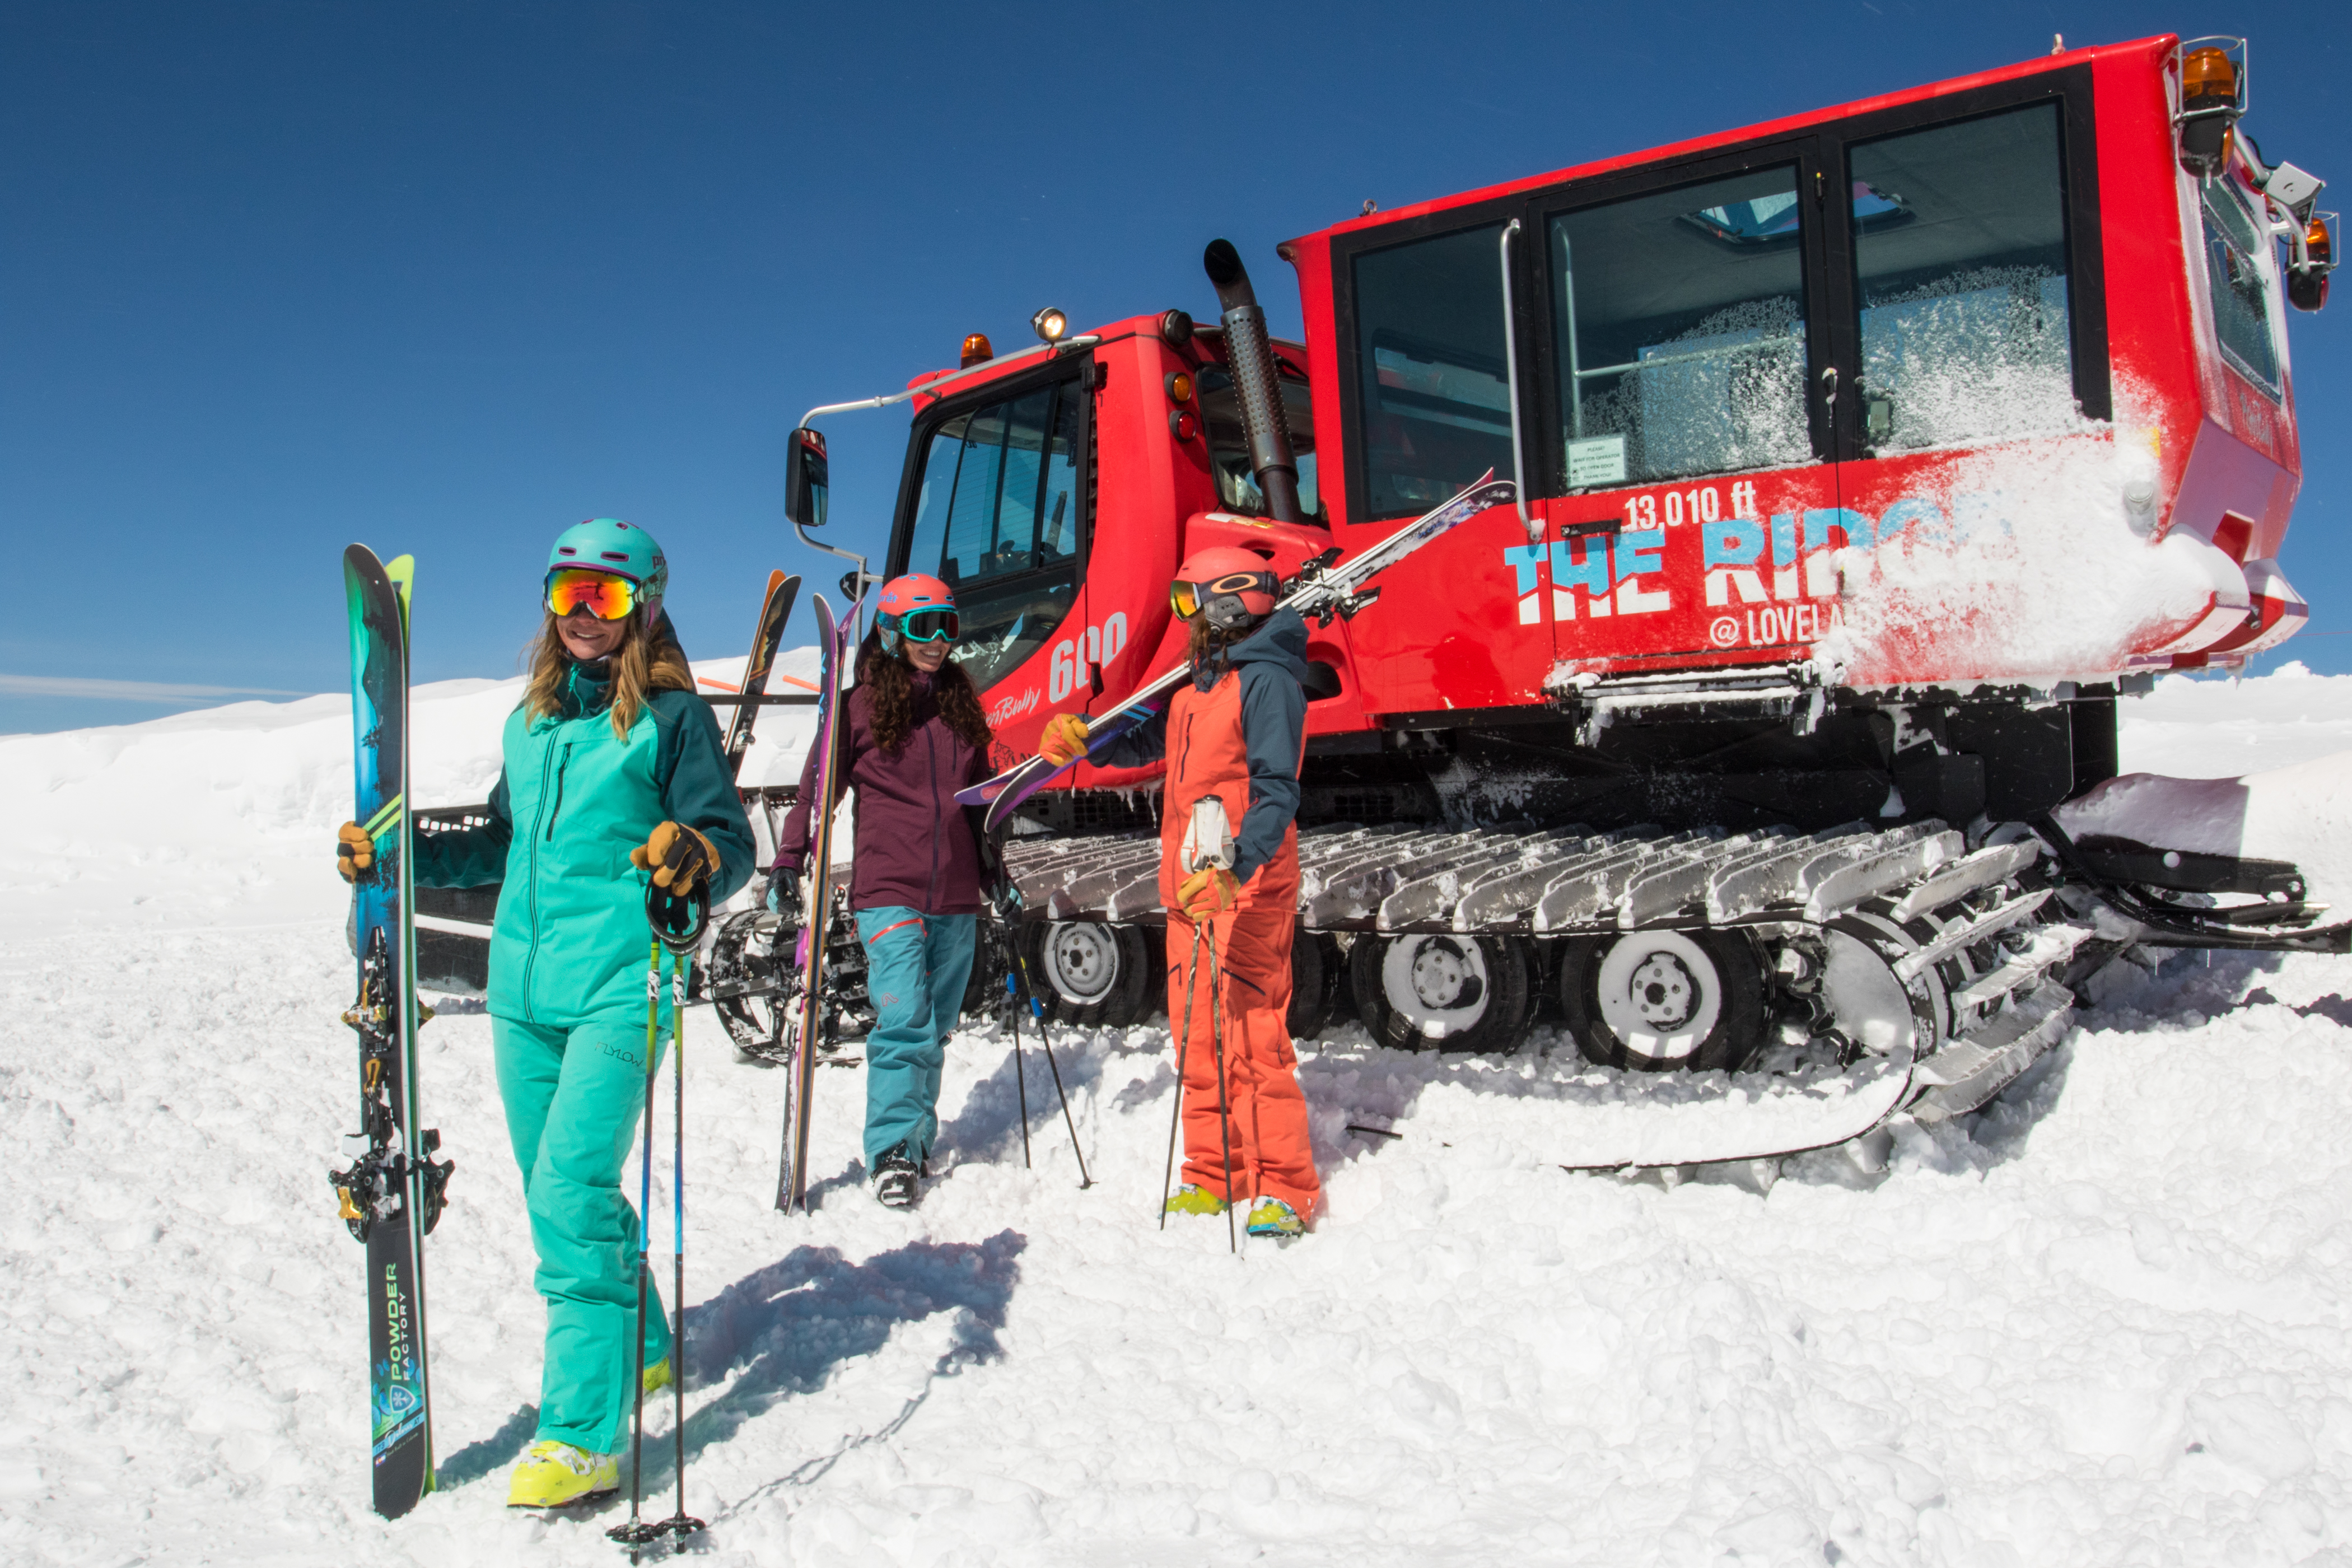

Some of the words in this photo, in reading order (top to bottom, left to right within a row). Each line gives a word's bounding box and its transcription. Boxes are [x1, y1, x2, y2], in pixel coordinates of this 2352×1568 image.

[1624, 486, 1719, 531] 13,010
[1730, 480, 1757, 520] ft
[1505, 530, 1669, 624] THE
[1049, 612, 1127, 703] 600
[1709, 615, 1739, 648] @
[595, 1042, 643, 1067] FLYLOW
[385, 1262, 402, 1381] POWDER
[399, 1292, 411, 1381] FACTORY
